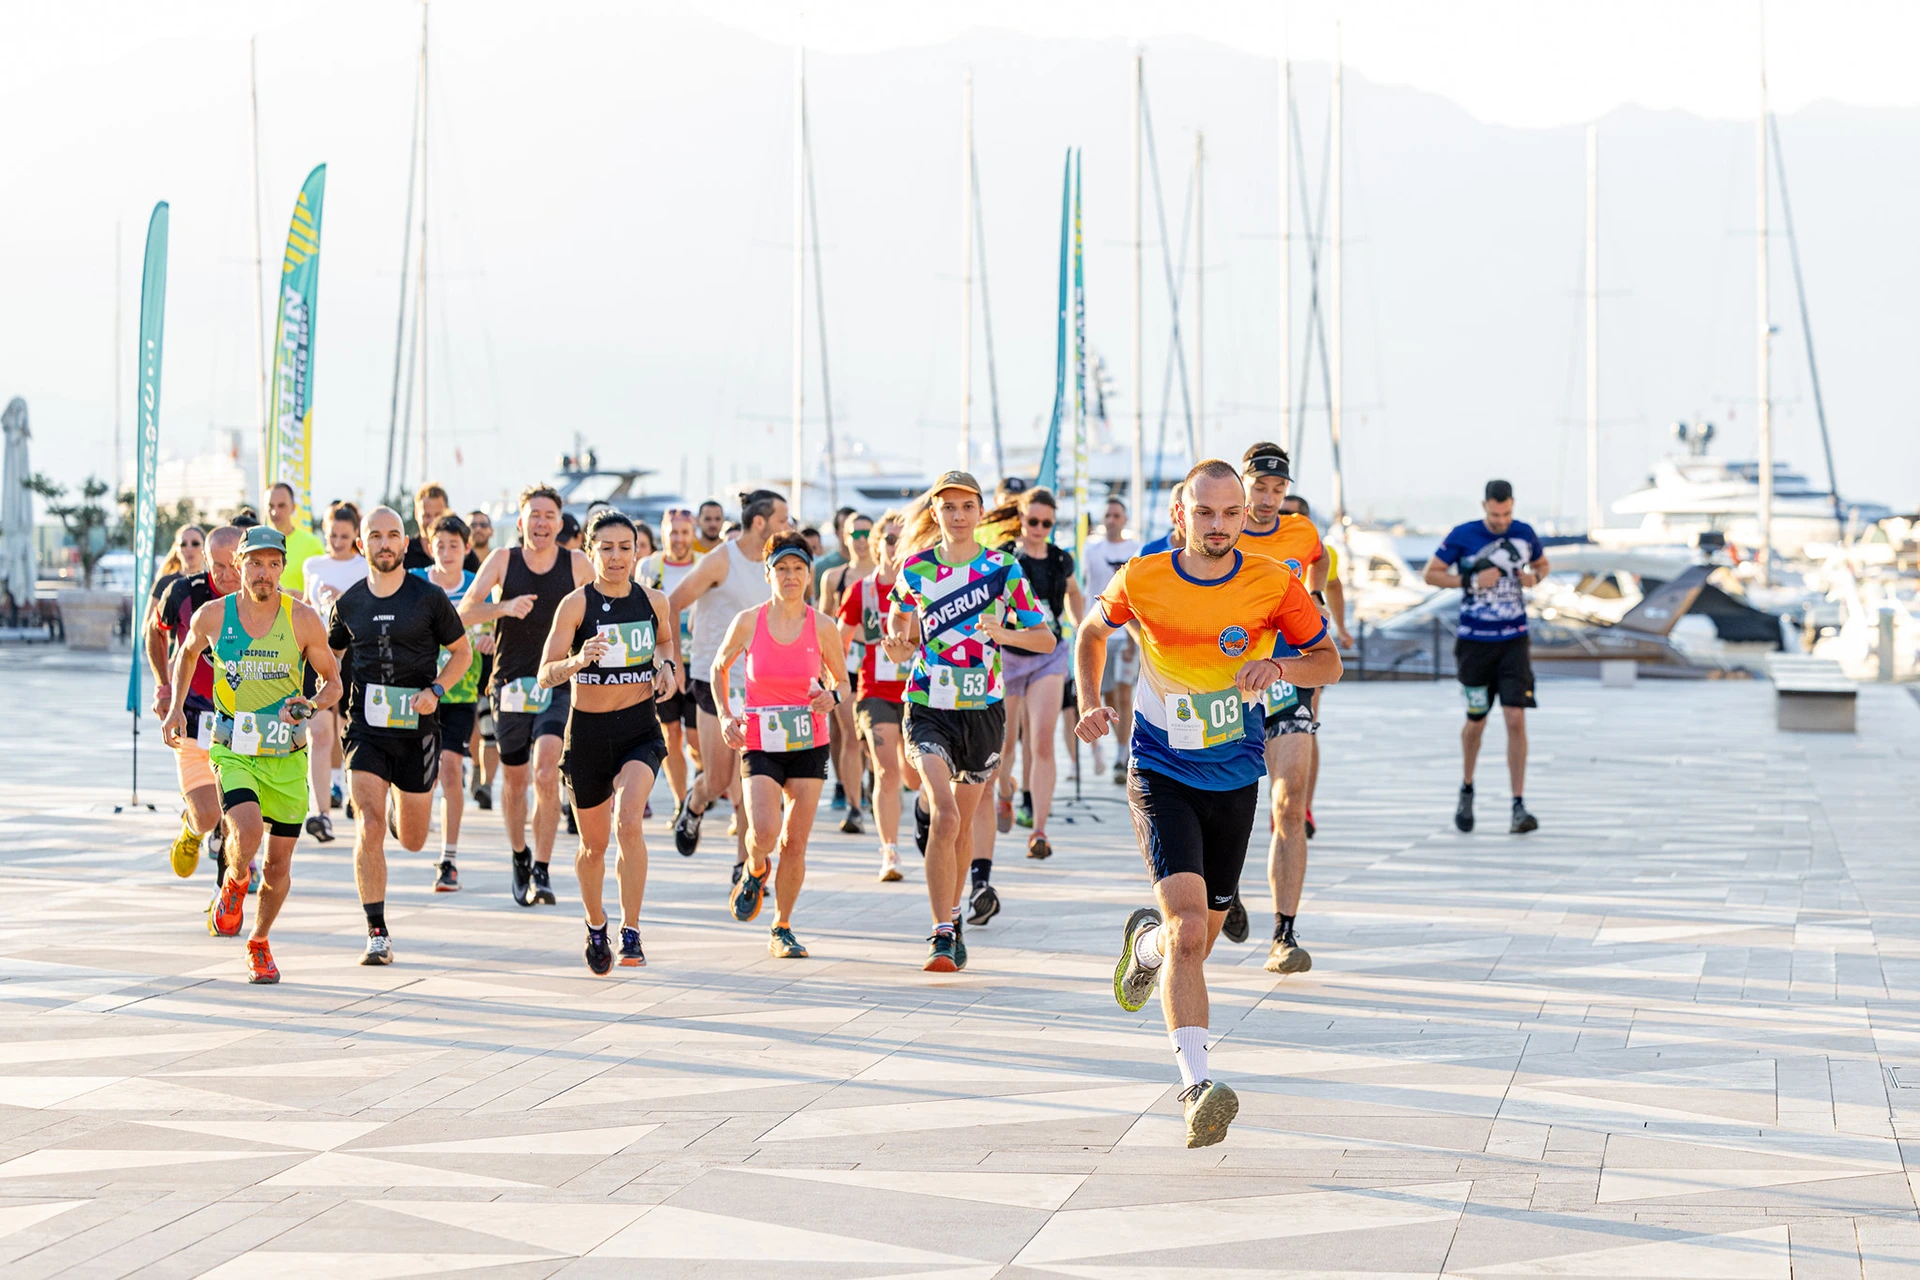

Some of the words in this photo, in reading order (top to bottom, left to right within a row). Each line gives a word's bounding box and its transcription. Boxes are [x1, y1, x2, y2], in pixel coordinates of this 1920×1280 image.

[278, 283, 303, 489] RIATLON
[631, 627, 653, 652] 04
[238, 660, 292, 674] TRIATLON
[963, 673, 985, 697] 53
[1271, 680, 1294, 701] 55
[1210, 695, 1239, 728] 03
[266, 720, 290, 744] 26
[793, 714, 811, 738] 15
